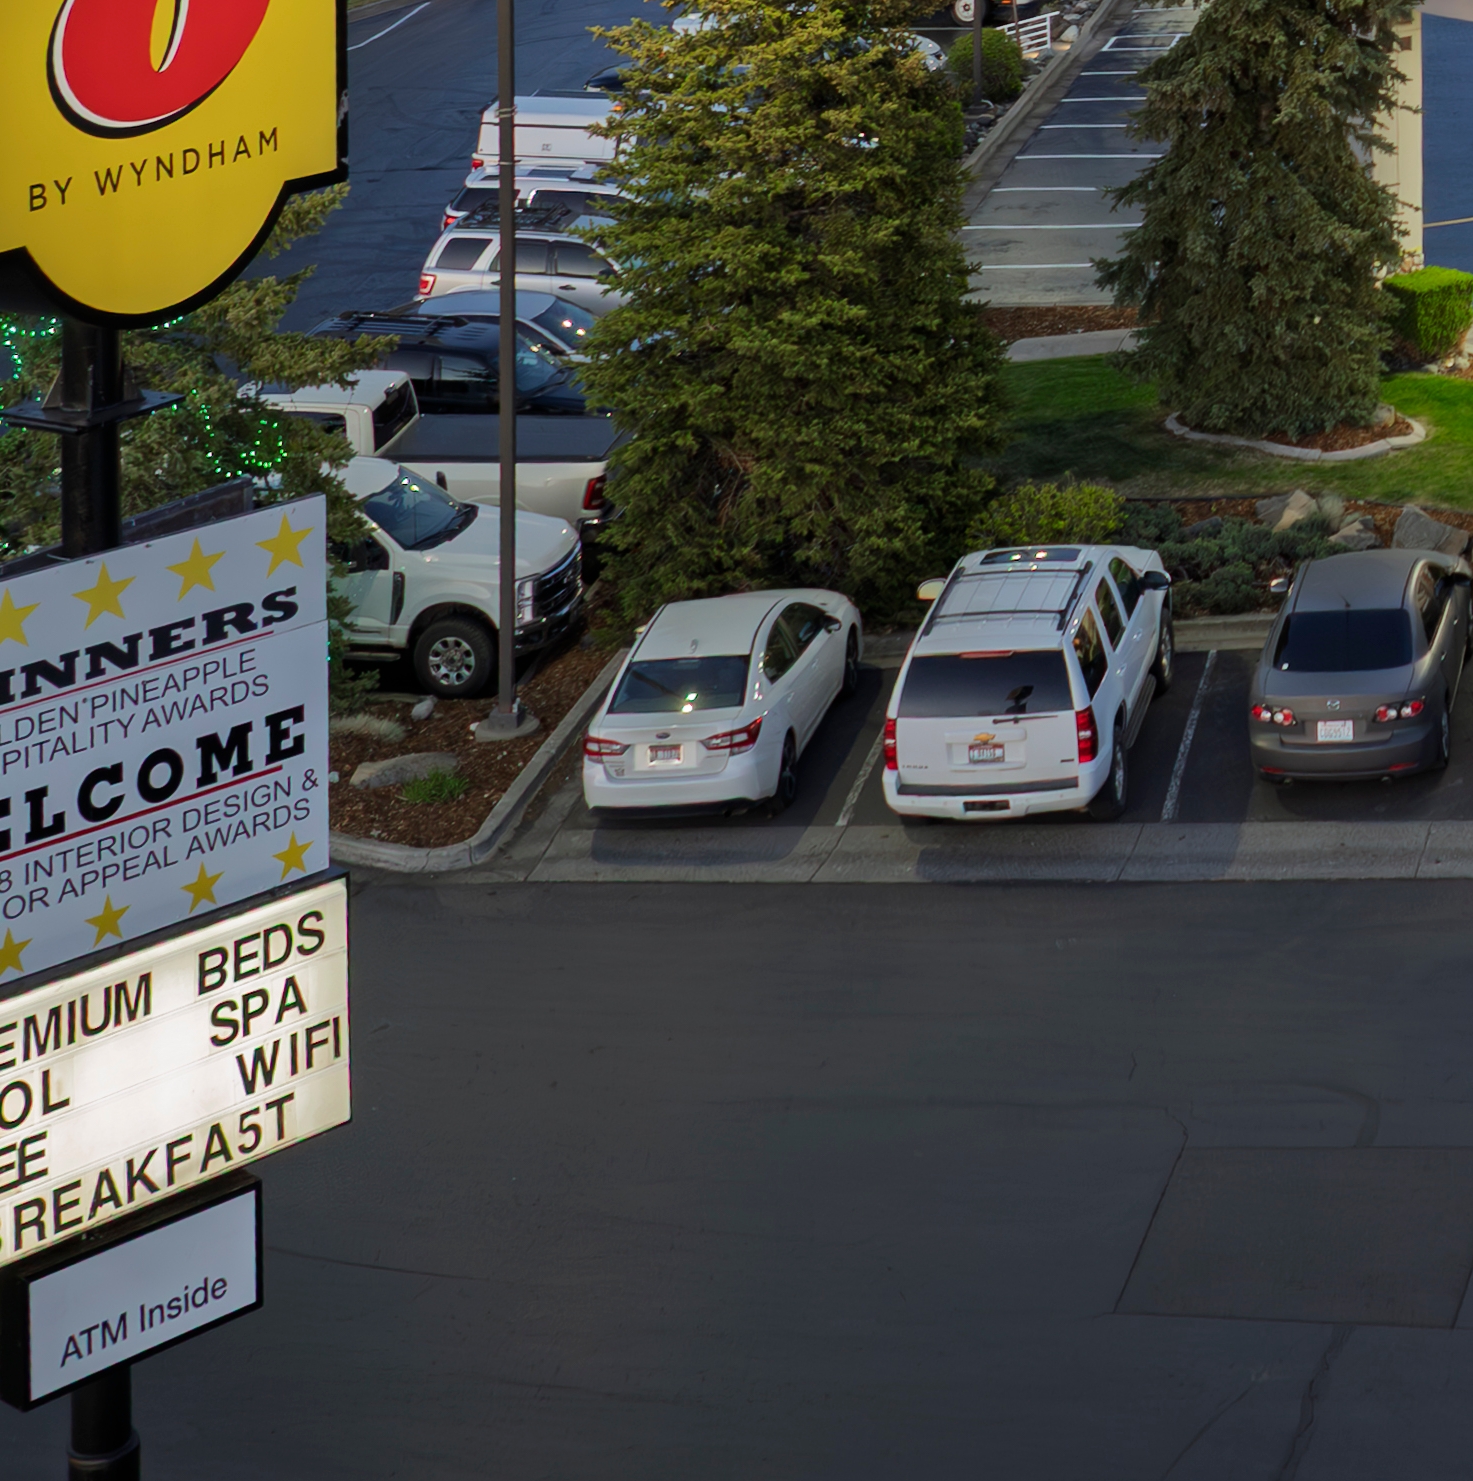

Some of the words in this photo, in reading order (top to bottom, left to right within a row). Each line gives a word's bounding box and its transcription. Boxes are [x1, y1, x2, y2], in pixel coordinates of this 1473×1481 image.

[29, 176, 73, 213] BY
[94, 126, 280, 196] WYNDHAM
[90, 648, 257, 719] PINEAPPLE
[141, 674, 270, 734] AWARDS
[25, 817, 172, 887] INTERIOR
[182, 776, 293, 834] DESIGN
[301, 768, 319, 792] &
[57, 845, 179, 904] APPEAL
[186, 797, 311, 860] AWARDS
[198, 910, 326, 996] BEDS
[210, 975, 308, 1048] SPA
[236, 1016, 341, 1096] WIFI
[60, 1311, 128, 1368] ATM
[139, 1276, 228, 1333] Inside
